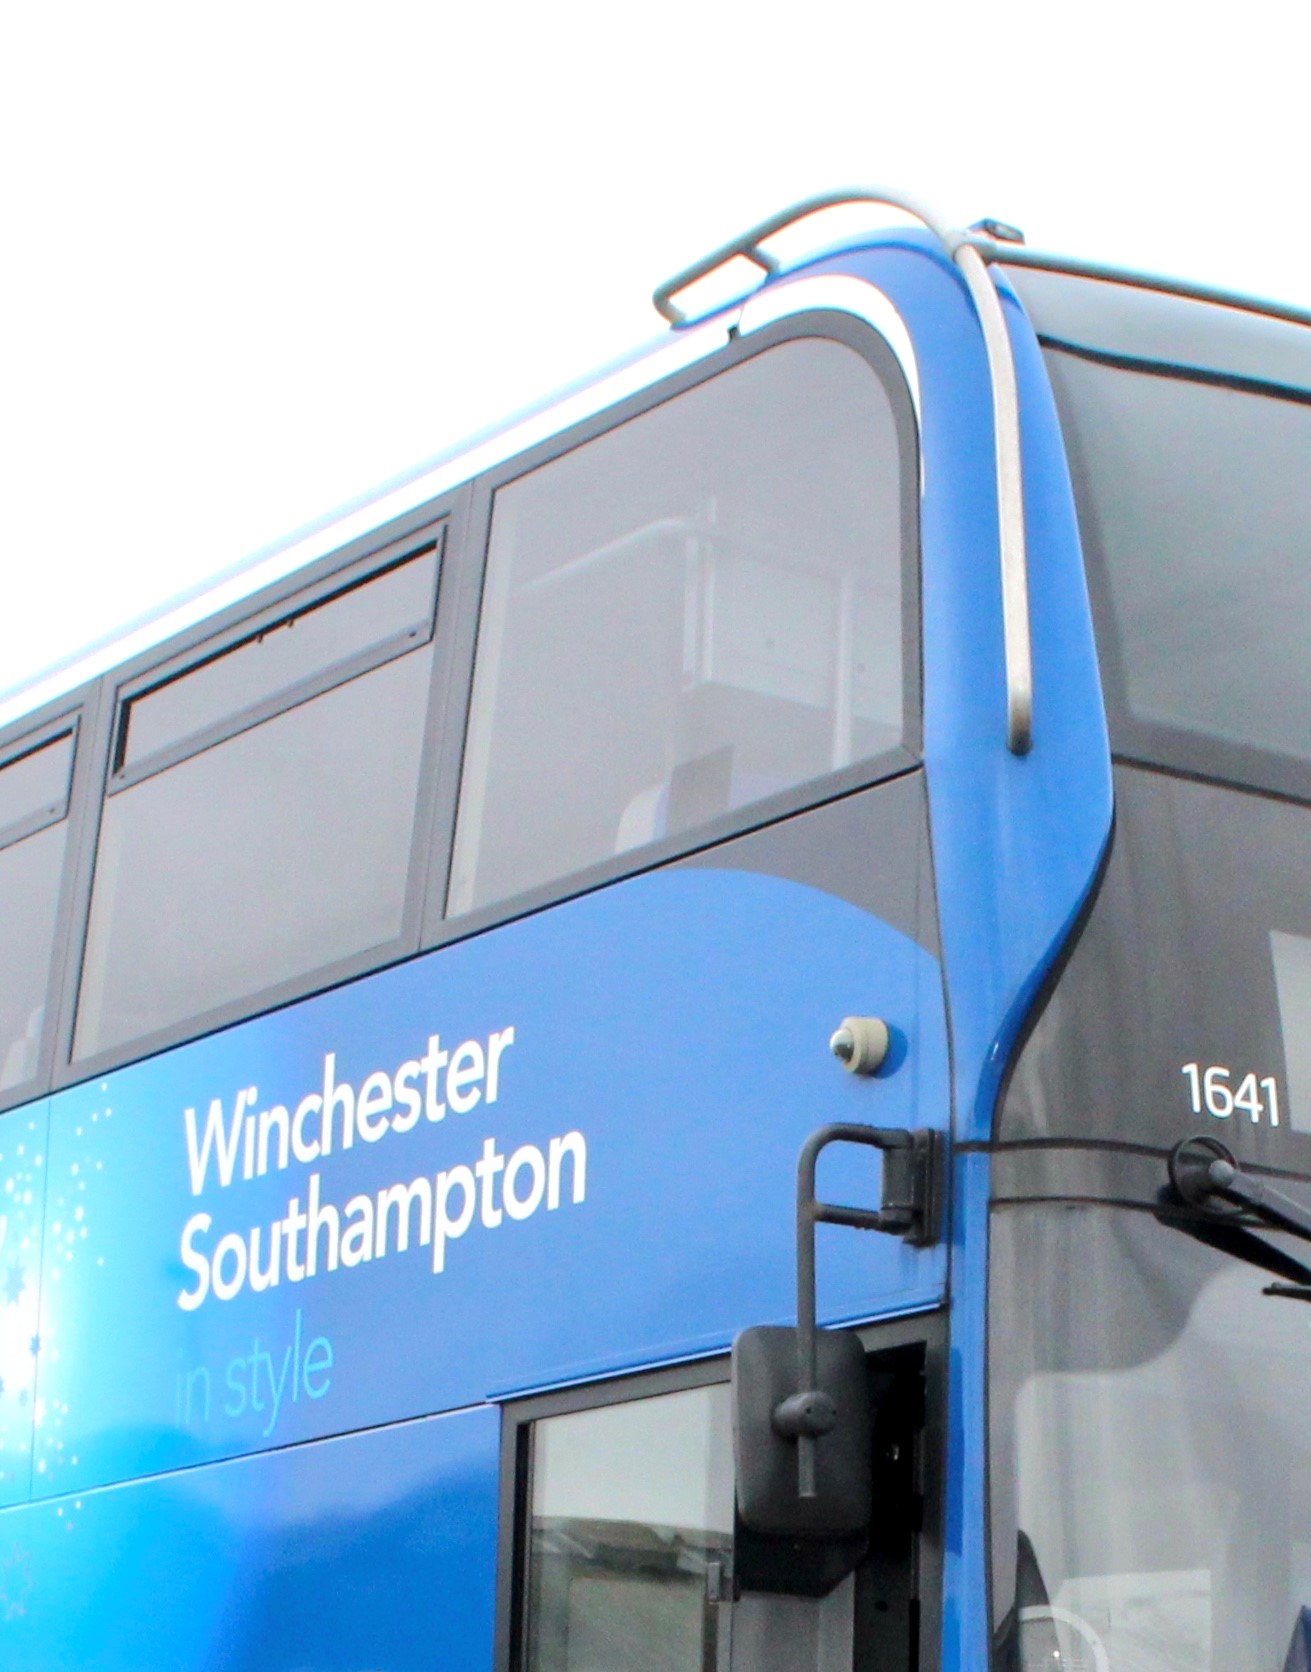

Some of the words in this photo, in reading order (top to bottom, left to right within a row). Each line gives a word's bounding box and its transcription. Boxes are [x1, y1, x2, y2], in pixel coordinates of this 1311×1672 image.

[184, 1025, 515, 1196] Winchester
[1181, 1062, 1279, 1127] 1641
[176, 1129, 587, 1312] Southampton
[224, 1308, 335, 1438] style
